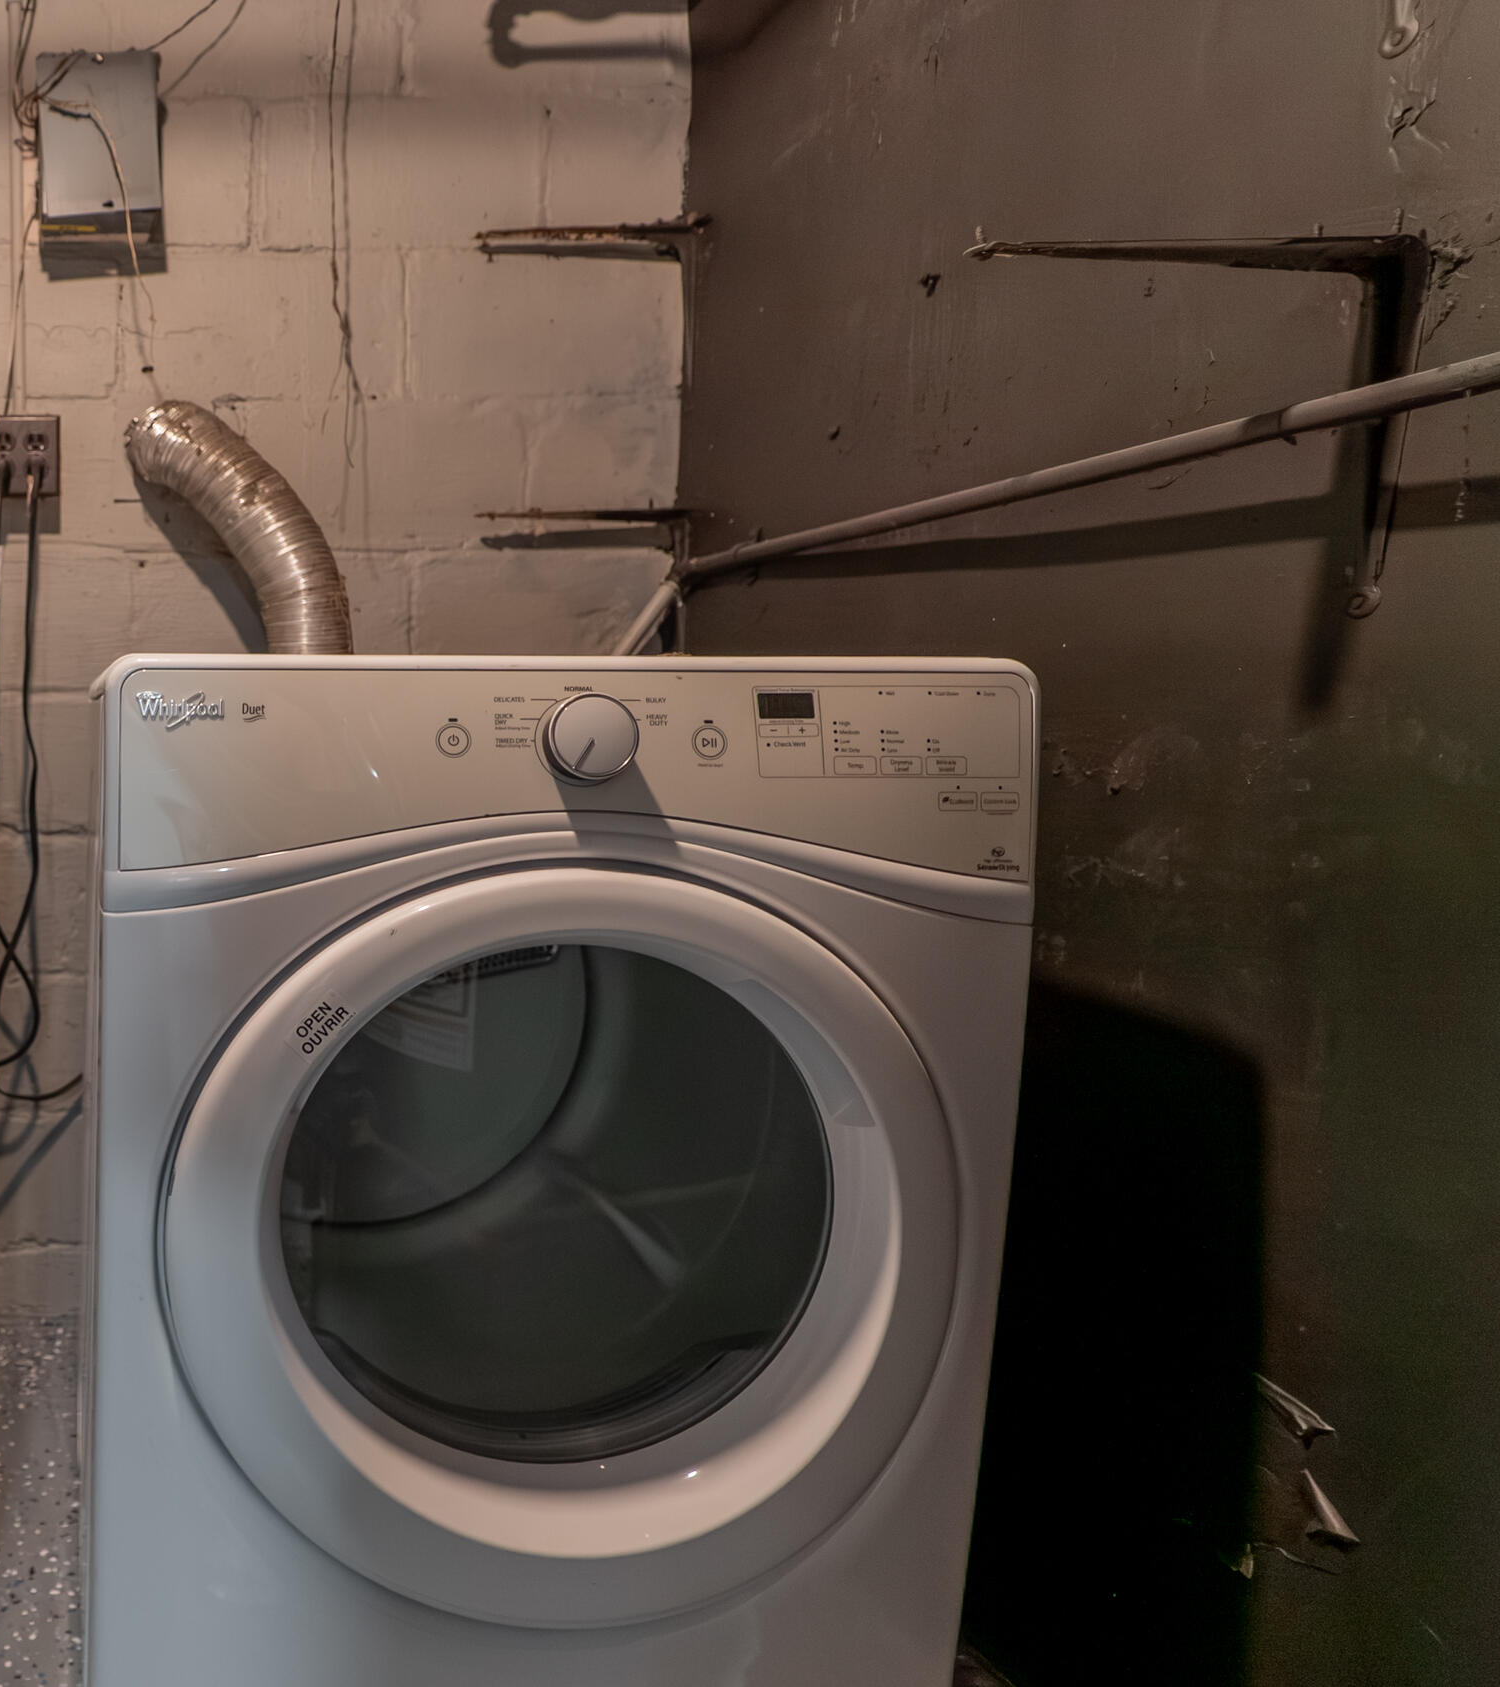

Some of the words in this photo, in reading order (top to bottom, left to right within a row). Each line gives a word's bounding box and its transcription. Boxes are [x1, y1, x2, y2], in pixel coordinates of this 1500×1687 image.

[136, 693, 225, 725] Whirlpool
[241, 702, 266, 716] Duet
[296, 1001, 332, 1038] OPEN
[302, 1006, 349, 1054] OUVRIR
